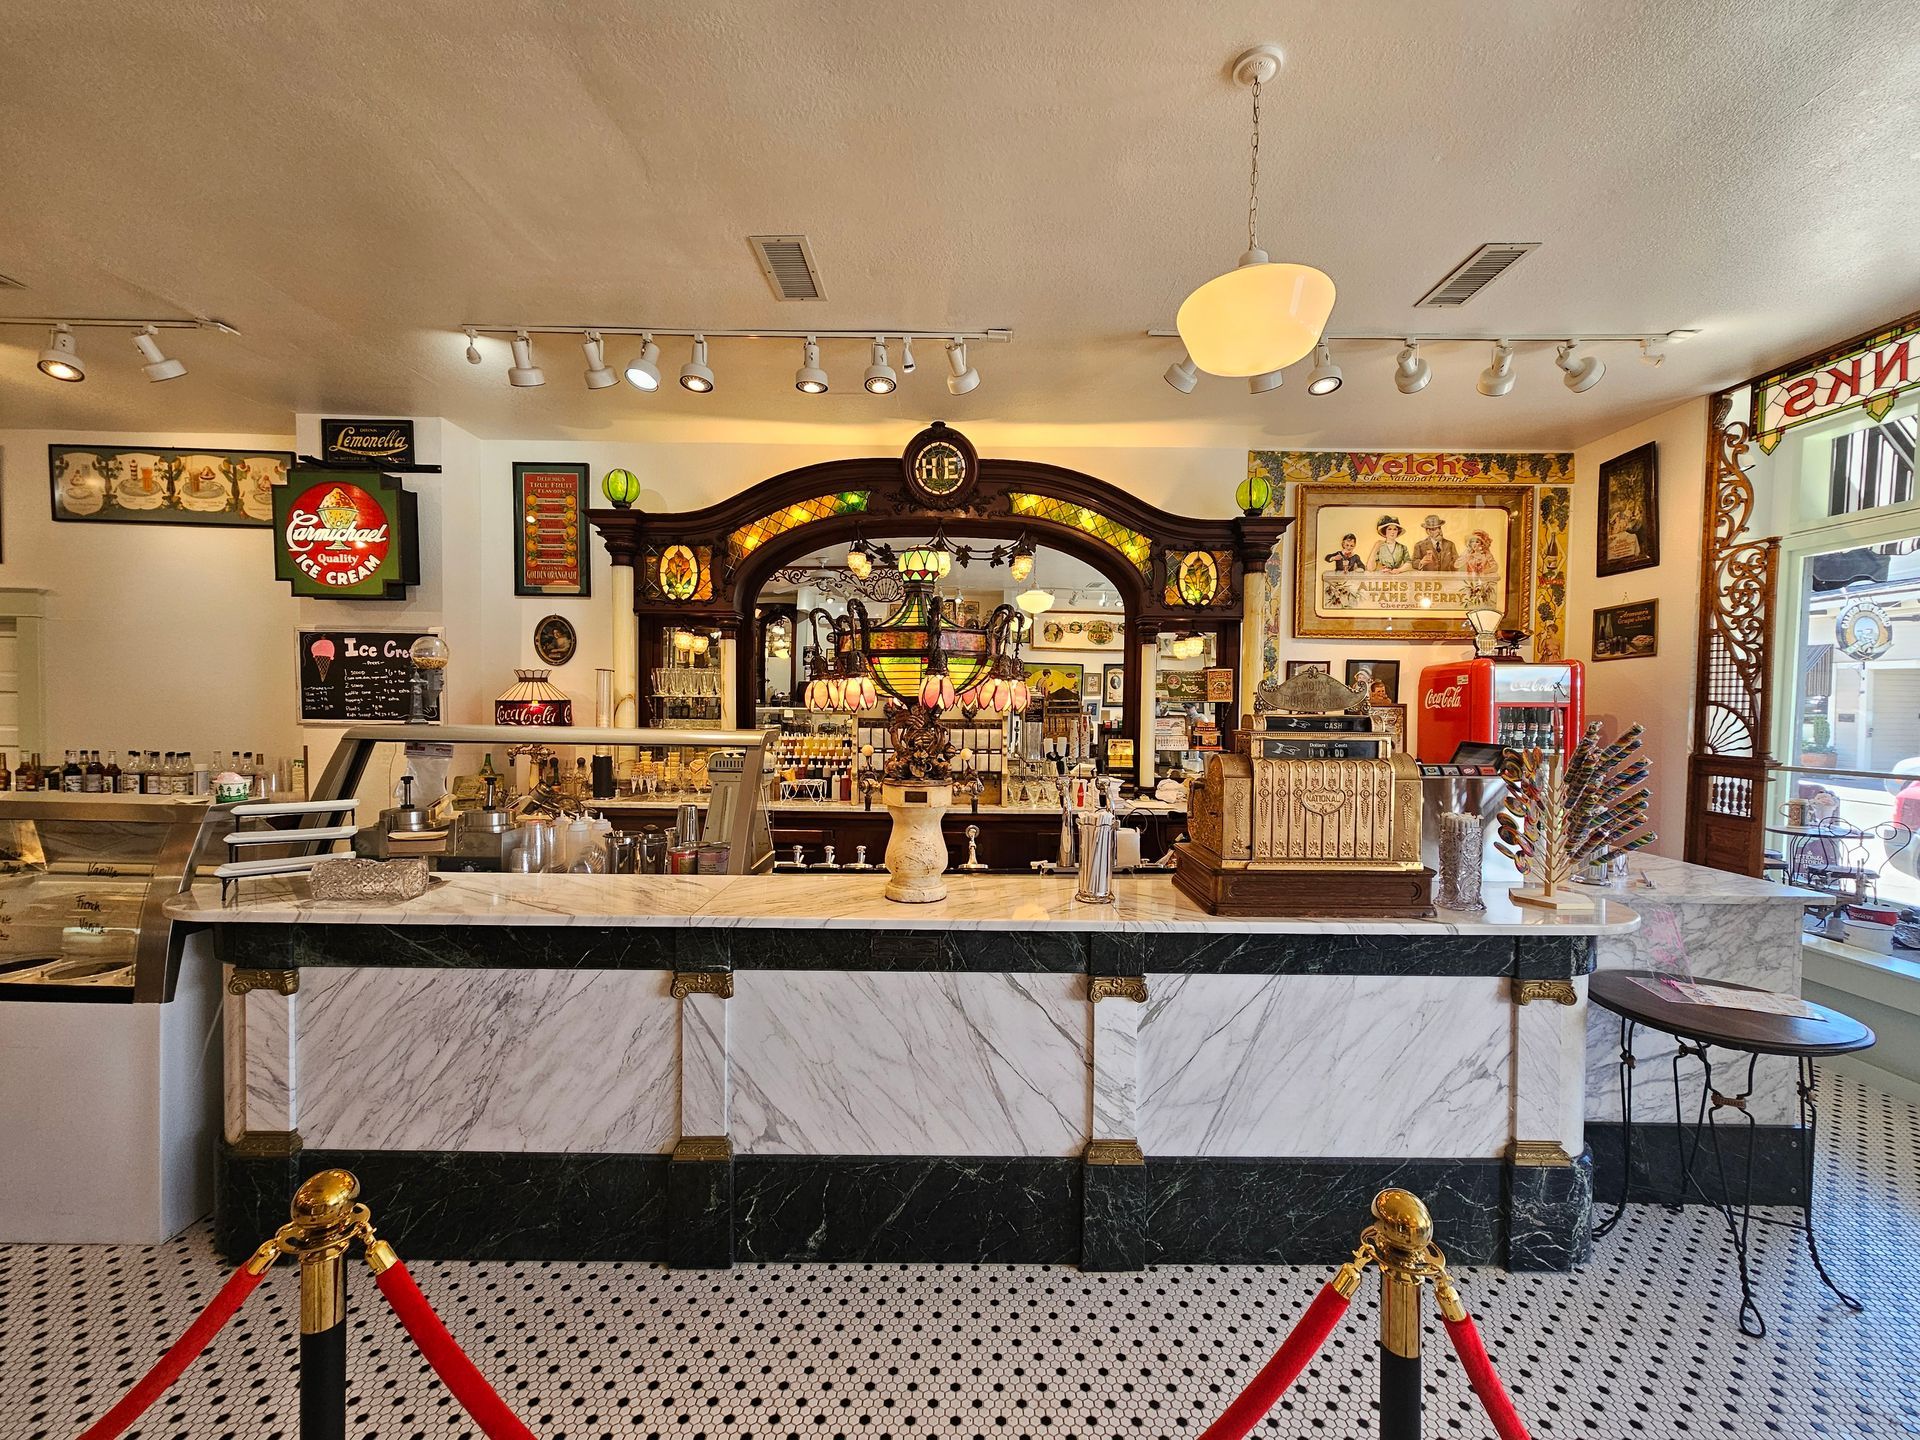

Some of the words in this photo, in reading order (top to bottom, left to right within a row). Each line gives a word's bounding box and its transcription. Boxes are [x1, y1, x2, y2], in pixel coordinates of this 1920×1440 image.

[329, 427, 408, 455] Lemonella
[1347, 452, 1480, 476] Welch's
[1385, 474, 1434, 482] National
[286, 509, 387, 551] Carmichael
[317, 553, 359, 566] Quality
[295, 553, 322, 579] ICE
[326, 554, 381, 585] CREAM
[1357, 581, 1408, 591] ALLENS
[1414, 581, 1443, 591] RED
[1369, 593, 1408, 602] TAME
[1414, 593, 1467, 603] CHERRY
[344, 638, 377, 657] Ice
[383, 640, 412, 658] Cre
[1425, 686, 1461, 709] Coca-Cola
[1306, 794, 1341, 803] NATIONAL
[87, 862, 120, 878] Vanilla
[75, 894, 102, 912] French
[79, 917, 105, 934] Vanilla
